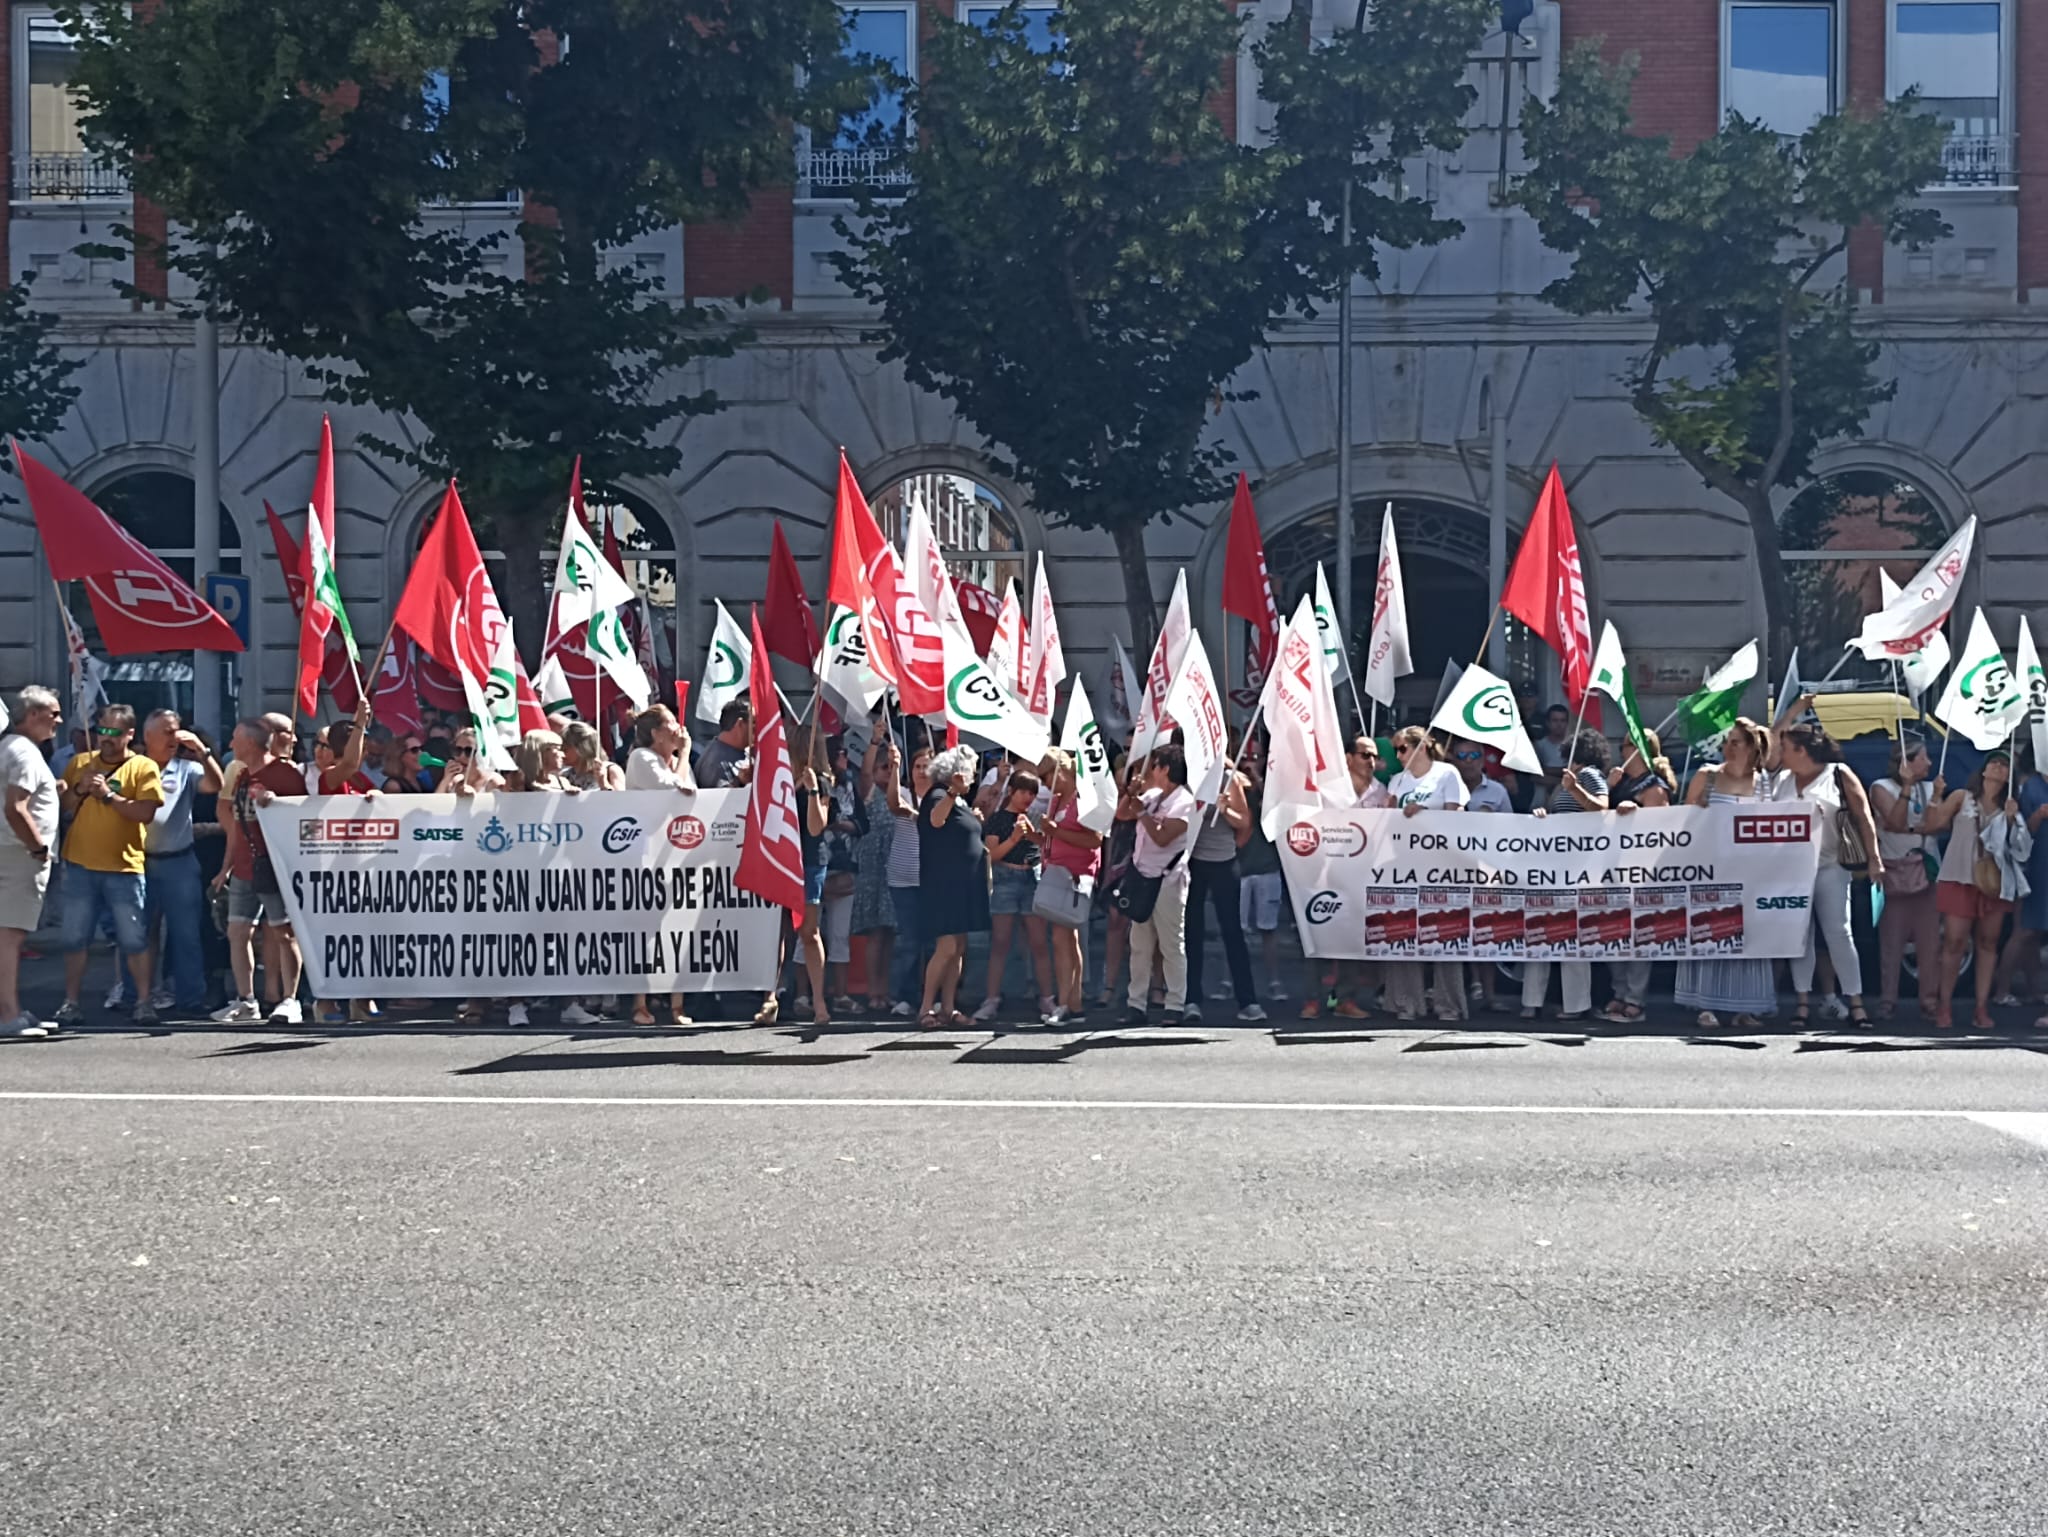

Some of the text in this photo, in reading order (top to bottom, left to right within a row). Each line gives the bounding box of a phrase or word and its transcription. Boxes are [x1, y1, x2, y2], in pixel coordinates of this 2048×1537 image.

[413, 828, 464, 841] SATSE
[518, 822, 583, 848] HSJD
[1737, 818, 1807, 839] CCOO
[1409, 834, 1449, 850] POR
[1457, 836, 1488, 850] UN
[1496, 836, 1611, 852] CONVENIO
[1620, 831, 1692, 849] DIGNO
[1371, 865, 1714, 885] Y LA CALIDAD EN LA ATENCION
[310, 869, 457, 913] TRABAJADORES
[464, 869, 487, 913] DE
[493, 869, 529, 912] SAN
[536, 868, 586, 912] JUAN
[593, 868, 616, 911] DE
[622, 867, 667, 911] DIOS
[672, 867, 697, 910] DE
[1756, 895, 1809, 910] SATSE
[325, 919, 739, 978] POR NUESTRO FUTURO EN CASTILLA Y LEÓN
